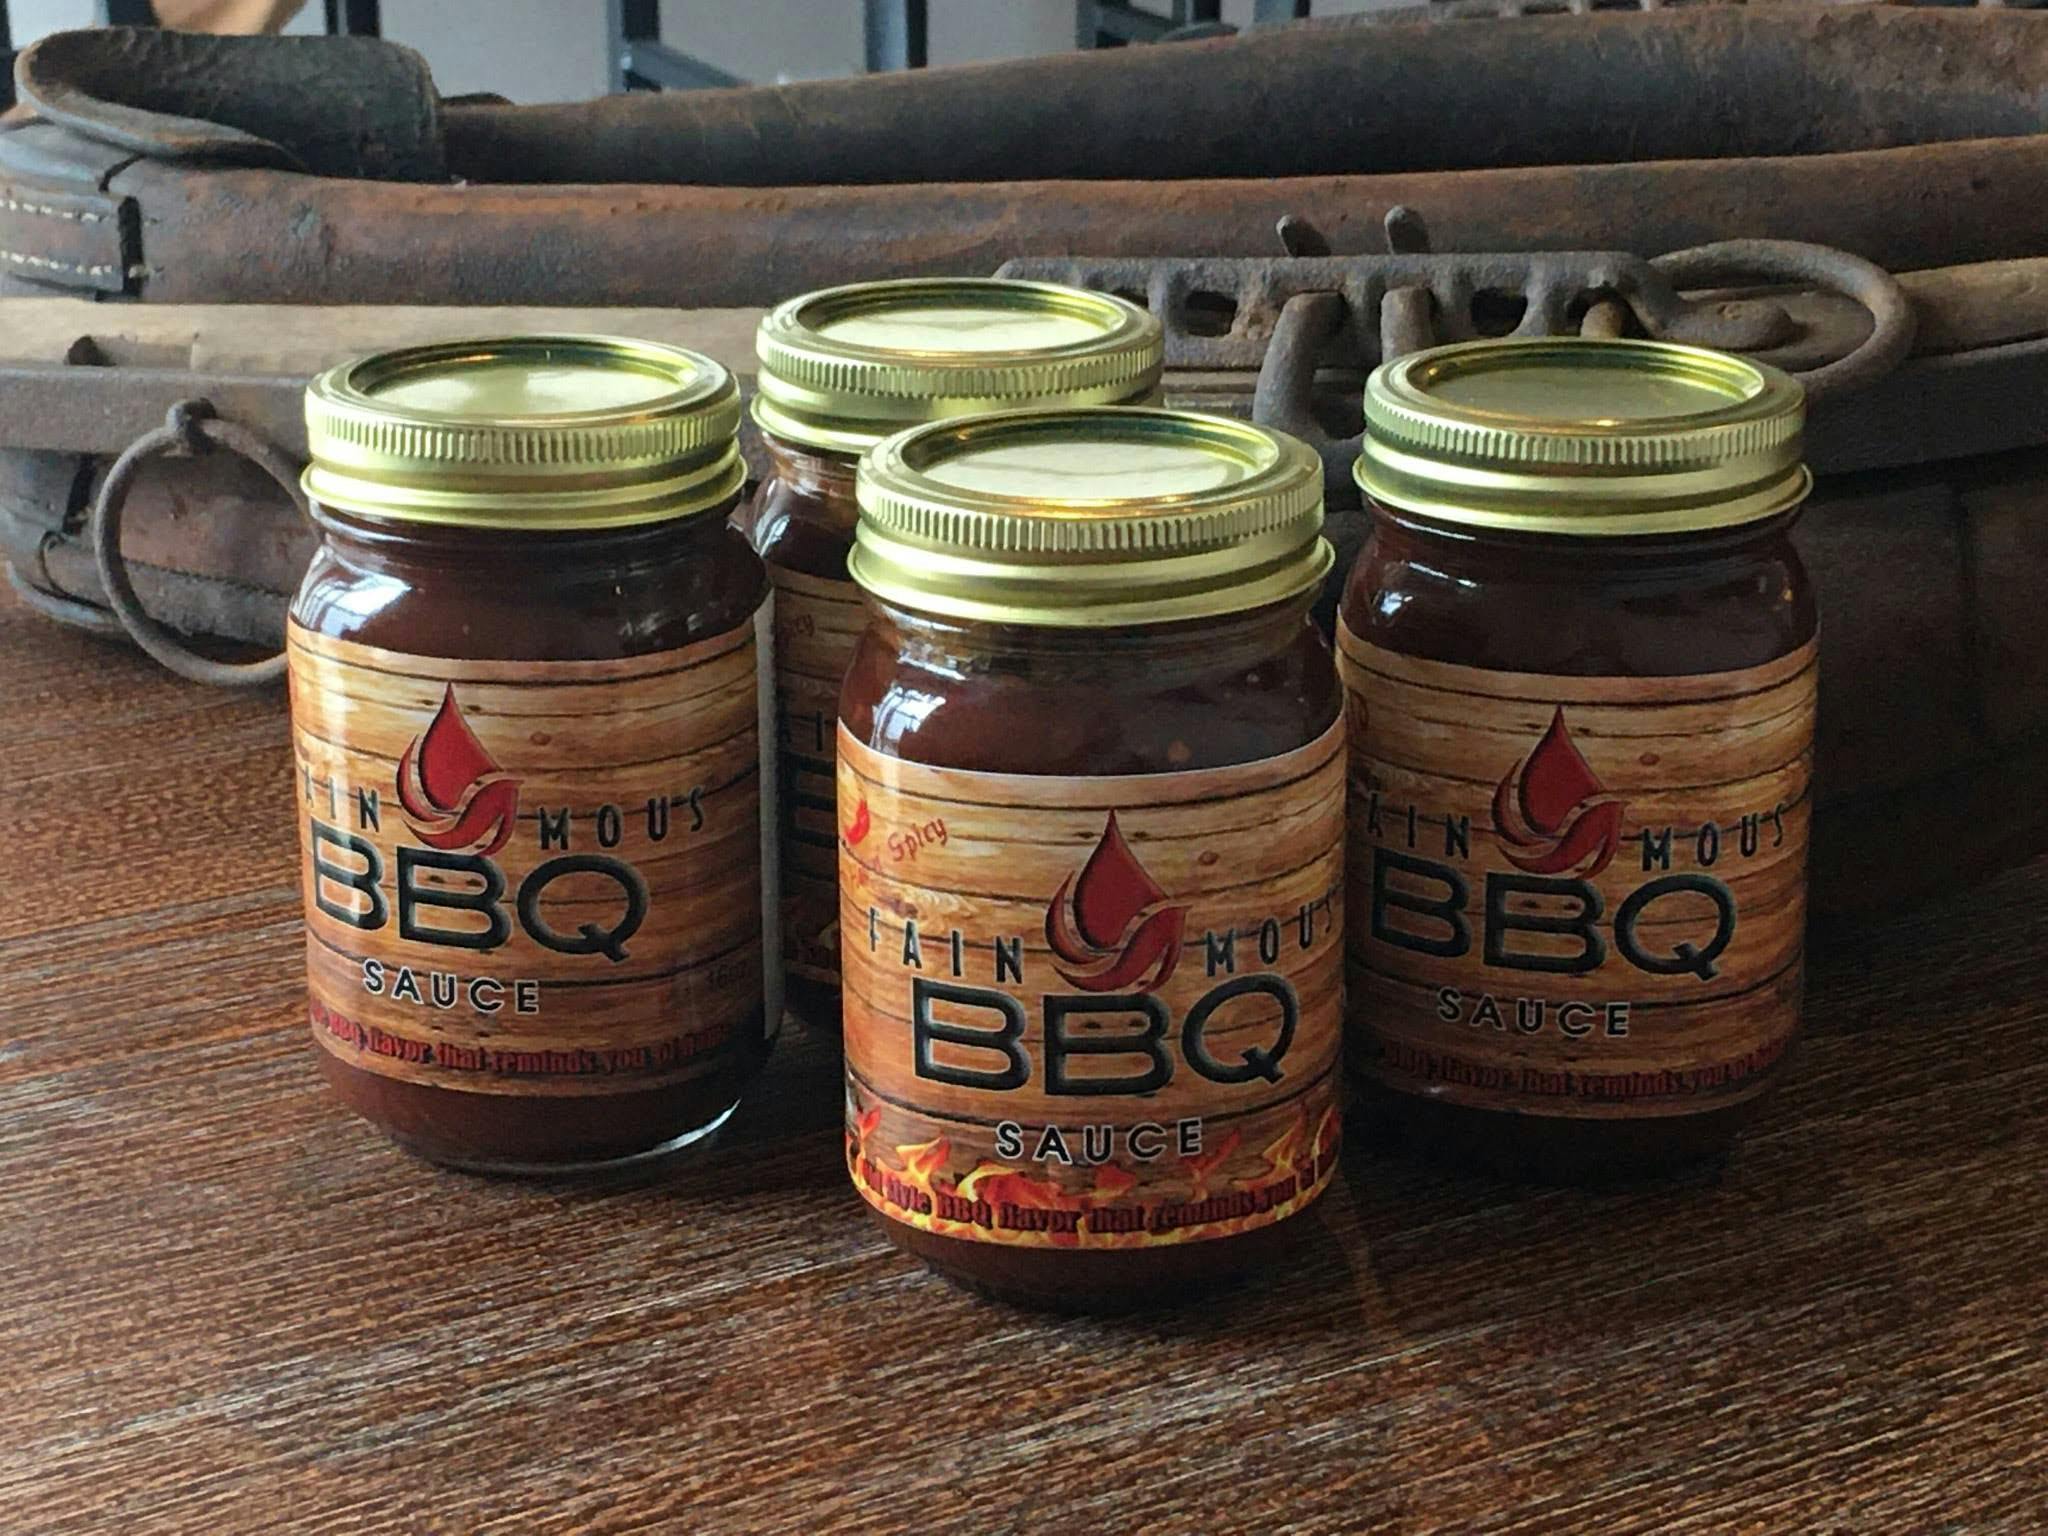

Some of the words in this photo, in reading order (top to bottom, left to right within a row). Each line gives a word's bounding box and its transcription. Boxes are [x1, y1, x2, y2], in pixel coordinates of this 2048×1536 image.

[887, 817, 948, 862] Spicy
[311, 819, 650, 963] BBQ
[1370, 845, 1737, 981] BBQ
[363, 959, 541, 1015] SAUCE
[1437, 987, 1632, 1038] SAUCE
[367, 1027, 434, 1064] flavor
[433, 1042, 485, 1072] that
[487, 1047, 597, 1074] reminds
[911, 973, 1299, 1097] BBQ
[994, 1116, 1202, 1164] SAUCE
[936, 1192, 993, 1230] BBQ
[999, 1202, 1082, 1235] flavor
